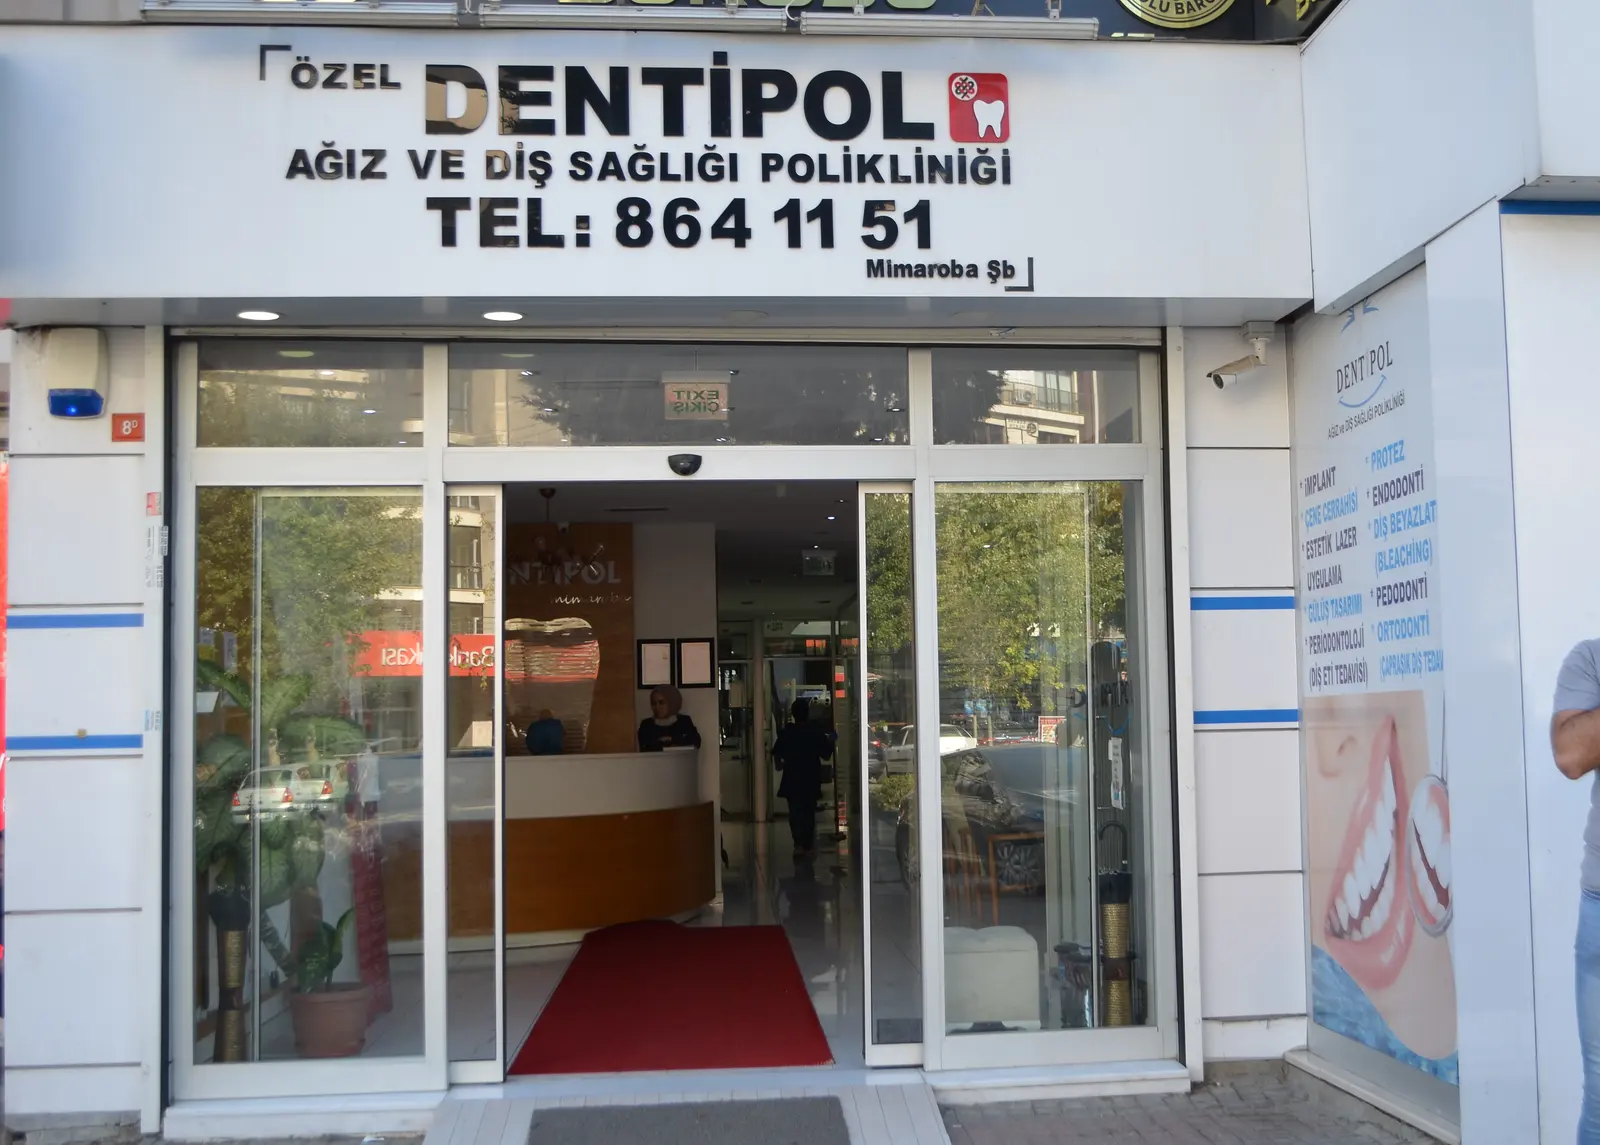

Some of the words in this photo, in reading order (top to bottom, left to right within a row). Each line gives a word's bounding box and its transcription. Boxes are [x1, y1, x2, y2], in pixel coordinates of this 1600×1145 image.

[291, 56, 401, 90] ÖZEL
[425, 51, 935, 141] DENTİPOL
[285, 142, 388, 181] AĞIZ
[407, 149, 465, 180] VE
[486, 141, 554, 189] DİŞ
[568, 144, 740, 184] SAĞLIĞI
[761, 145, 1012, 185] POLİKLİNİĞİ
[426, 197, 591, 249] TEL:
[614, 196, 752, 249] 864
[774, 198, 834, 249] 11
[861, 199, 932, 249] 51
[866, 258, 979, 280] Mimaroba
[987, 259, 1016, 284] Şb
[1371, 439, 1405, 472] PROTEZ
[1372, 464, 1424, 506] ENDODONTİ
[1305, 506, 1321, 533] ÇENE
[1373, 511, 1388, 541] DİŞ
[1389, 500, 1438, 535] BEYAZLAT
[1306, 531, 1333, 560] ESTETİK
[1335, 526, 1358, 552] LAZER
[1307, 564, 1343, 592] UYGULAMA
[1376, 571, 1428, 607] PEDODONTİ
[1308, 598, 1329, 625] GÜLÜŞ
[1377, 610, 1430, 643] ORTODONTİ
[1309, 622, 1365, 655] PERİODONTOLOJİ
[1322, 661, 1334, 686] ETİ
